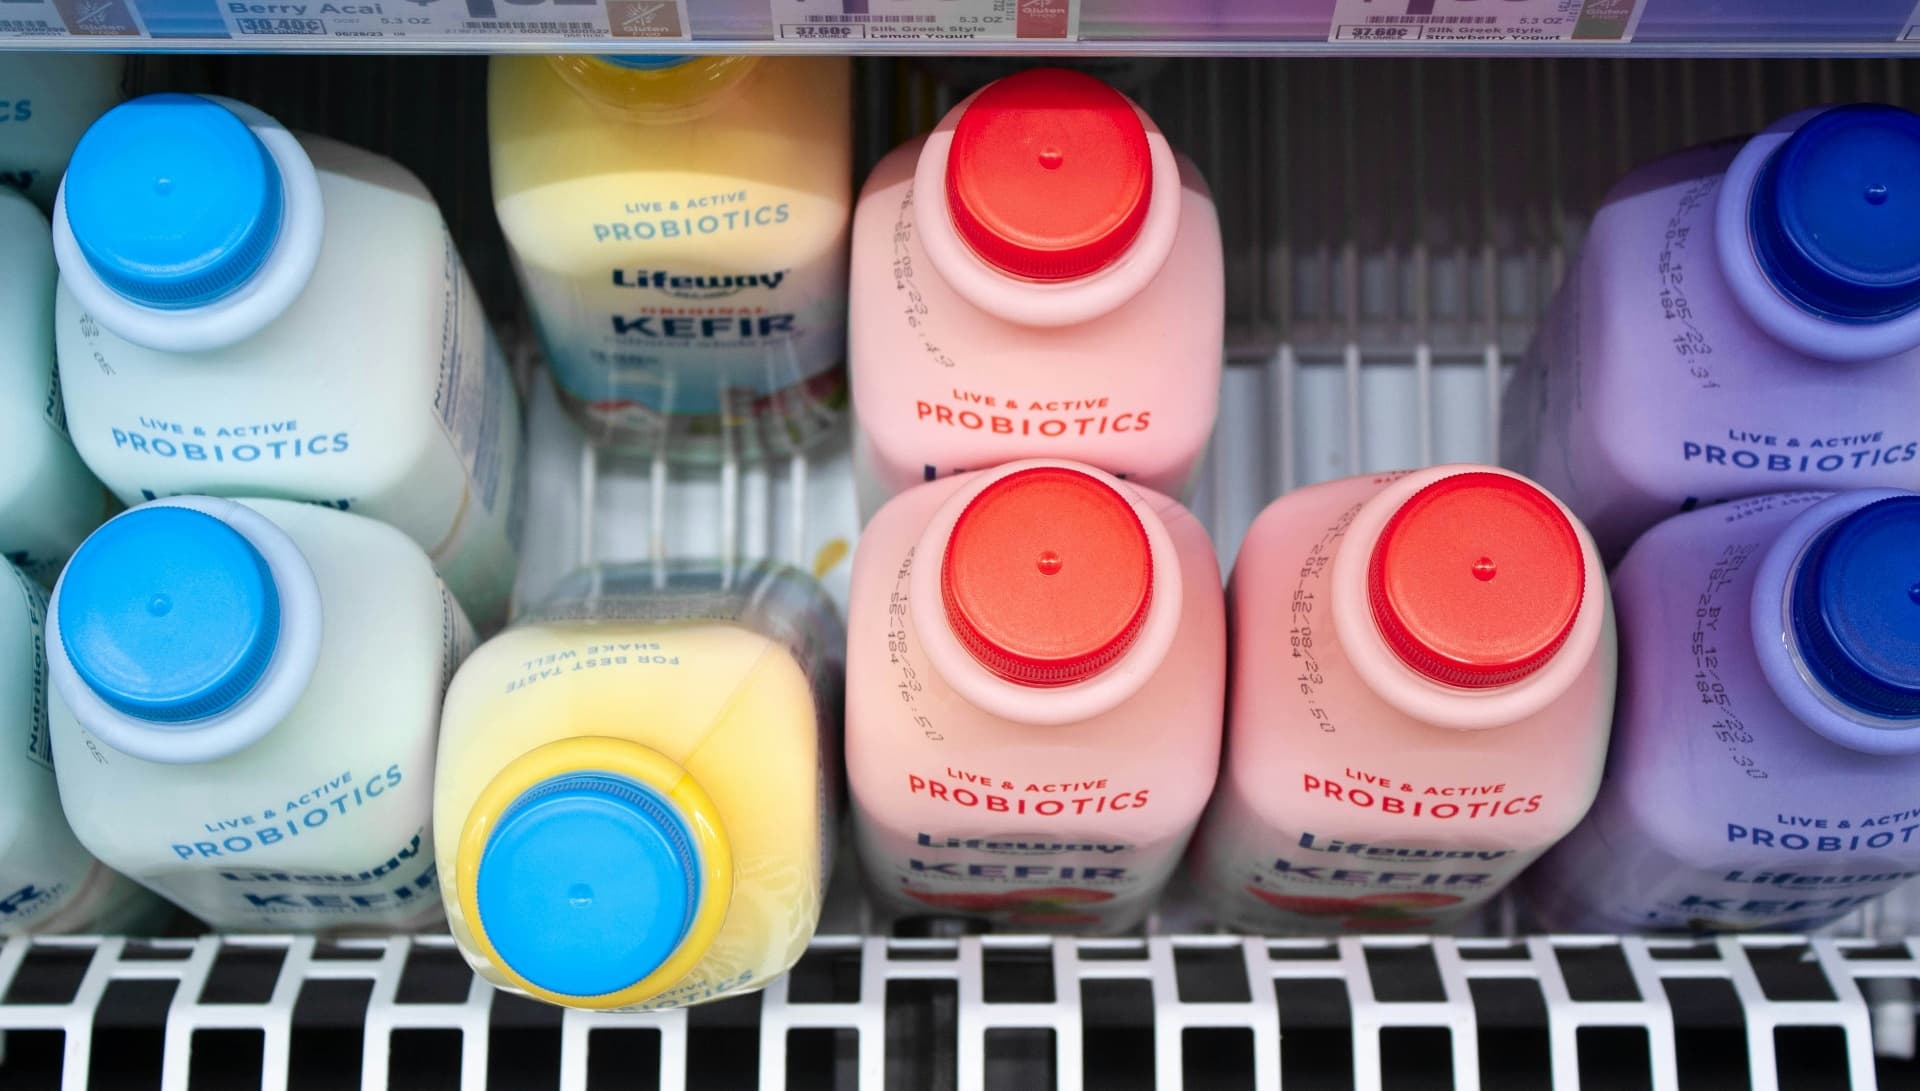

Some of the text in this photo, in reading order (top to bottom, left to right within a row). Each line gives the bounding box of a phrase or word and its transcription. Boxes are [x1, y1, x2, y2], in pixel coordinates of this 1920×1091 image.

[227, 3, 306, 15] Berry
[320, 3, 383, 14] Acai
[796, 27, 852, 35] 37.60¢
[1352, 28, 1408, 36] 37.60¢
[625, 191, 748, 214] LIVE & ACTIVE
[593, 204, 790, 242] PROBIOTICS
[612, 269, 784, 289] Lifeway
[612, 314, 796, 338] KEFIR
[953, 388, 1109, 412] LIVE & ACTIVE
[140, 416, 297, 437] LIVE & ACTIVE
[917, 400, 1151, 438] PROBIOTICS
[112, 427, 349, 462] PROBIOTICS
[1729, 429, 1884, 448] LIVE & ACTIVE
[1683, 441, 1918, 473] PROBIOTICS
[1311, 556, 1329, 578] BY
[1706, 607, 1722, 631] BY
[896, 594, 923, 692] 12/08/23
[1301, 593, 1324, 685] 12/08/23
[523, 642, 661, 670] SHAKE WELL
[505, 655, 680, 694] FOR BEST TASTE
[29, 634, 41, 754] Nutrition
[1296, 675, 1336, 734] 16:50
[1704, 648, 1754, 745] 12/05/23
[947, 767, 1109, 793] LIVE & ACTIVE
[1346, 767, 1506, 797] LIVE & ACTIVE
[205, 771, 353, 833] LIVE & ACTIVE
[909, 774, 1150, 816] PROBIOTICS
[1304, 773, 1544, 819] PROBIOTICS
[172, 764, 403, 860] PROBIOTICS
[1777, 814, 1828, 829] LIVE
[1837, 820, 1851, 829] &
[917, 832, 1126, 854] Lifeway
[1298, 832, 1514, 861] Lifeway
[1727, 823, 1920, 852] PROBIOT
[909, 858, 1127, 880] KEFIR
[1274, 858, 1492, 886] KEFIR
